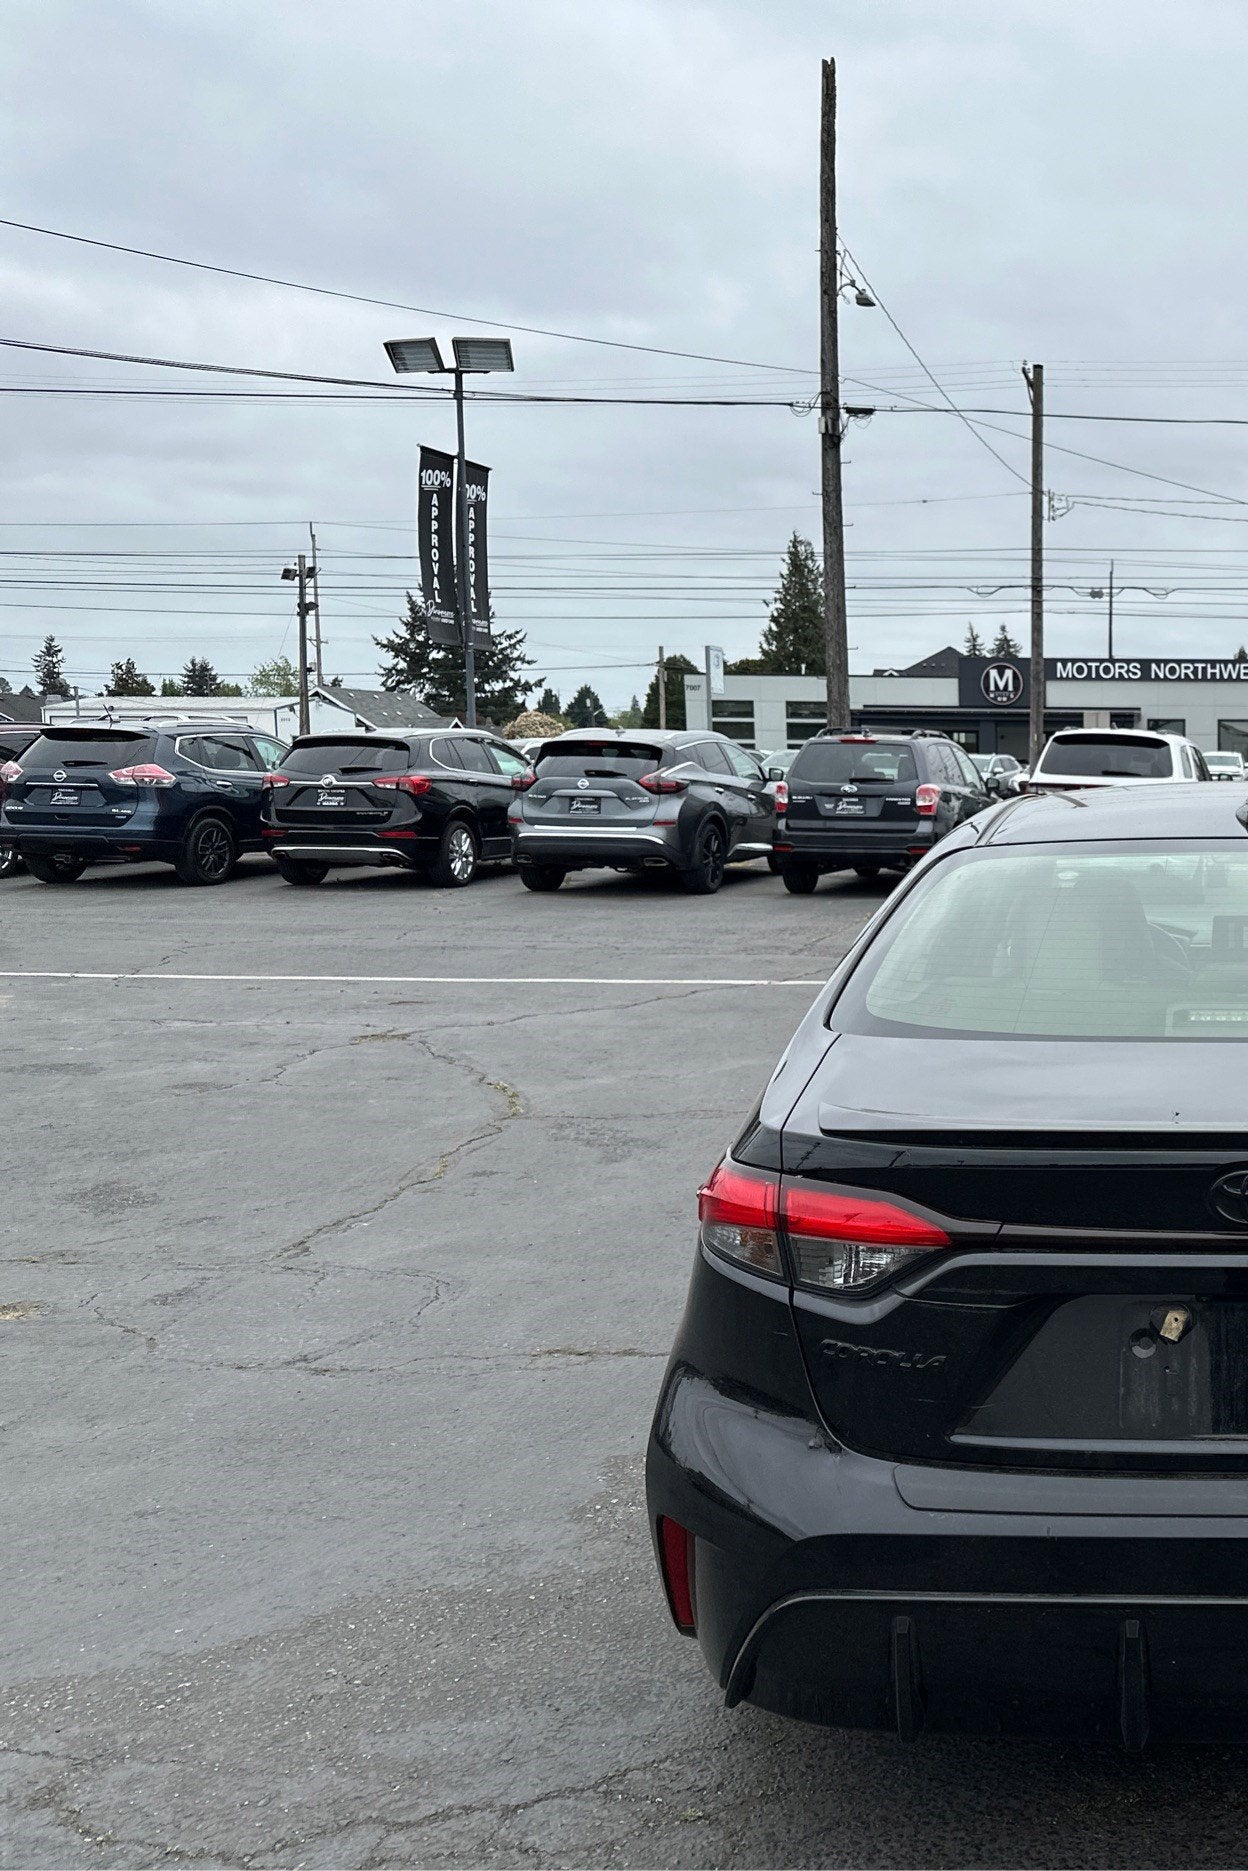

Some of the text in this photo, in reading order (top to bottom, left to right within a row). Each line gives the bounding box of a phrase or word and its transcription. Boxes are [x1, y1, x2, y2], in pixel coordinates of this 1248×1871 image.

[421, 469, 451, 487] 100%
[431, 493, 441, 603] APPROVAL
[469, 507, 477, 612] APPROVAL
[989, 668, 1014, 692] M
[1056, 662, 1142, 679] MOTORS
